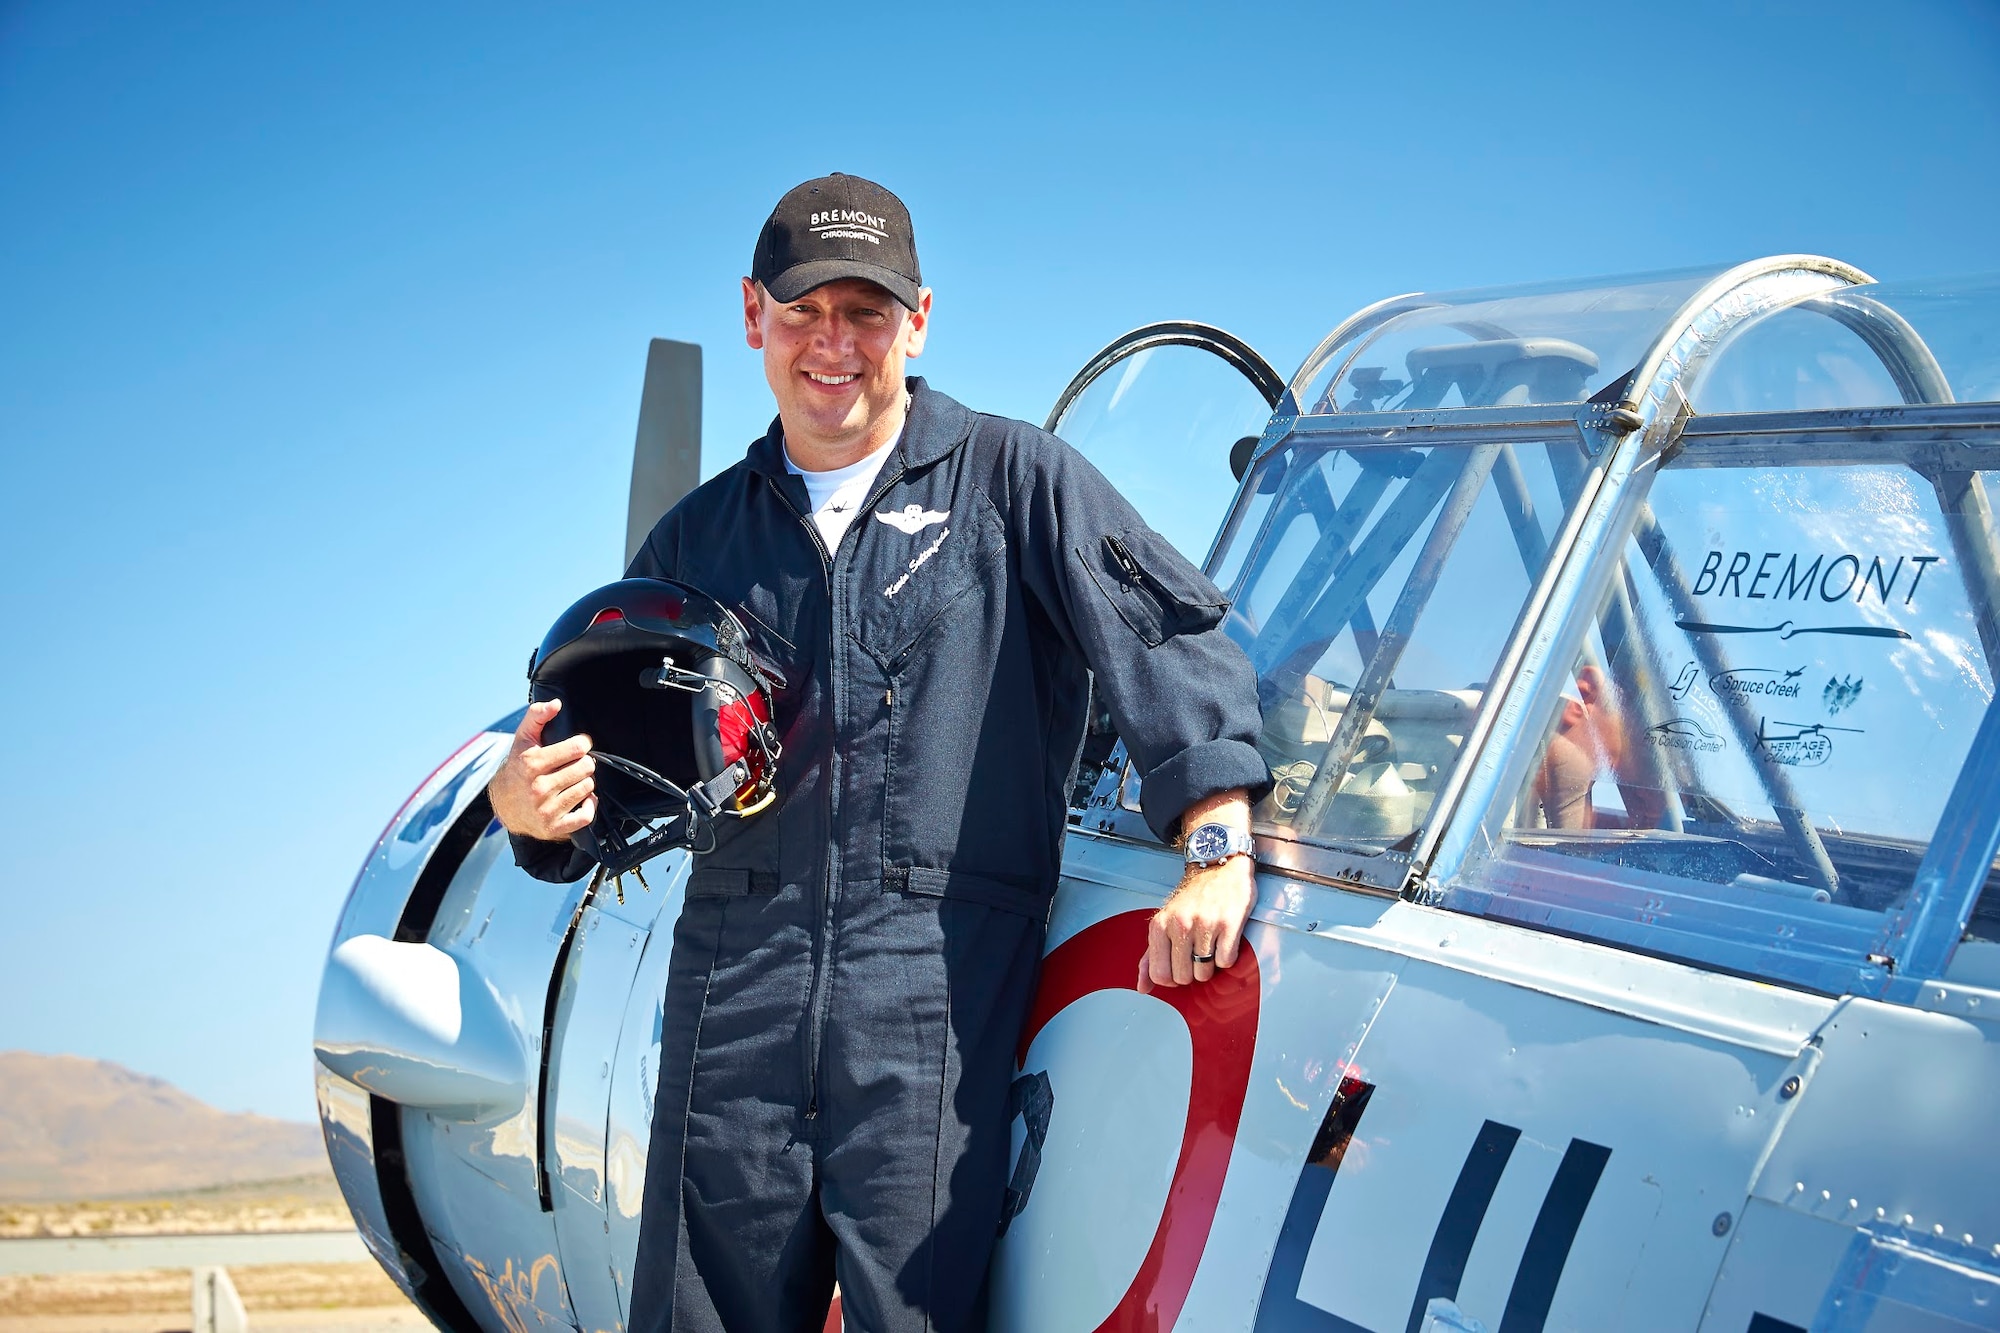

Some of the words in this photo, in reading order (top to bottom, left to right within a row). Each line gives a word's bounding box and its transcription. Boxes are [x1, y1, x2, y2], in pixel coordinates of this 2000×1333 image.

[811, 209, 887, 230] BREMONT
[821, 230, 881, 245] CHRONOMETERS
[1692, 551, 1940, 605] BREMONT
[1722, 675, 1764, 696] Spruce
[1765, 679, 1801, 698] Creek
[1658, 734, 1693, 750] Collision
[1693, 738, 1724, 753] Center
[1770, 740, 1826, 752] HERITAGE
[1802, 751, 1823, 761] AIR
